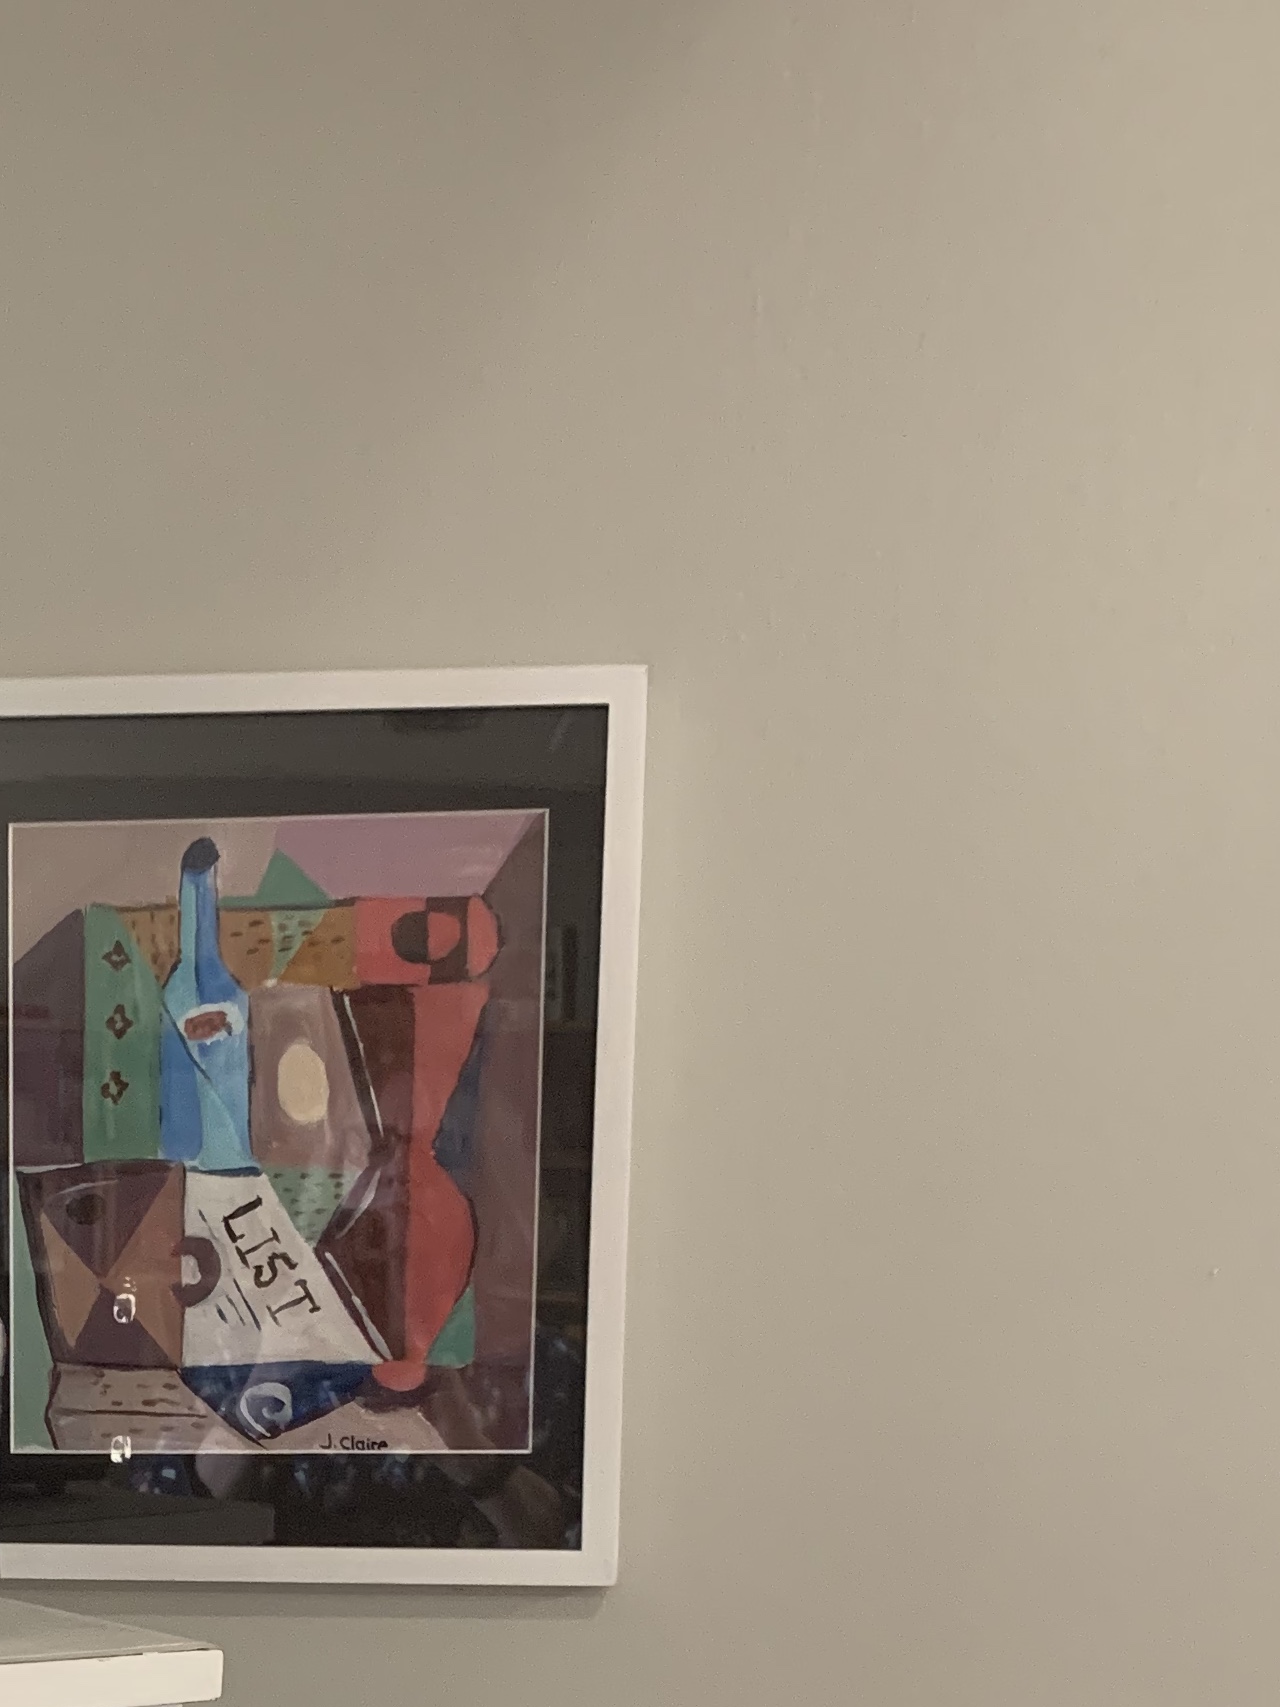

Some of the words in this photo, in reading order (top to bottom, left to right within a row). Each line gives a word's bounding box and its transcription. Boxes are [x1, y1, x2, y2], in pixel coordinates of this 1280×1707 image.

[221, 1195, 321, 1326] LIST
[319, 1433, 336, 1449] J.
[340, 1435, 388, 1450] Claire
